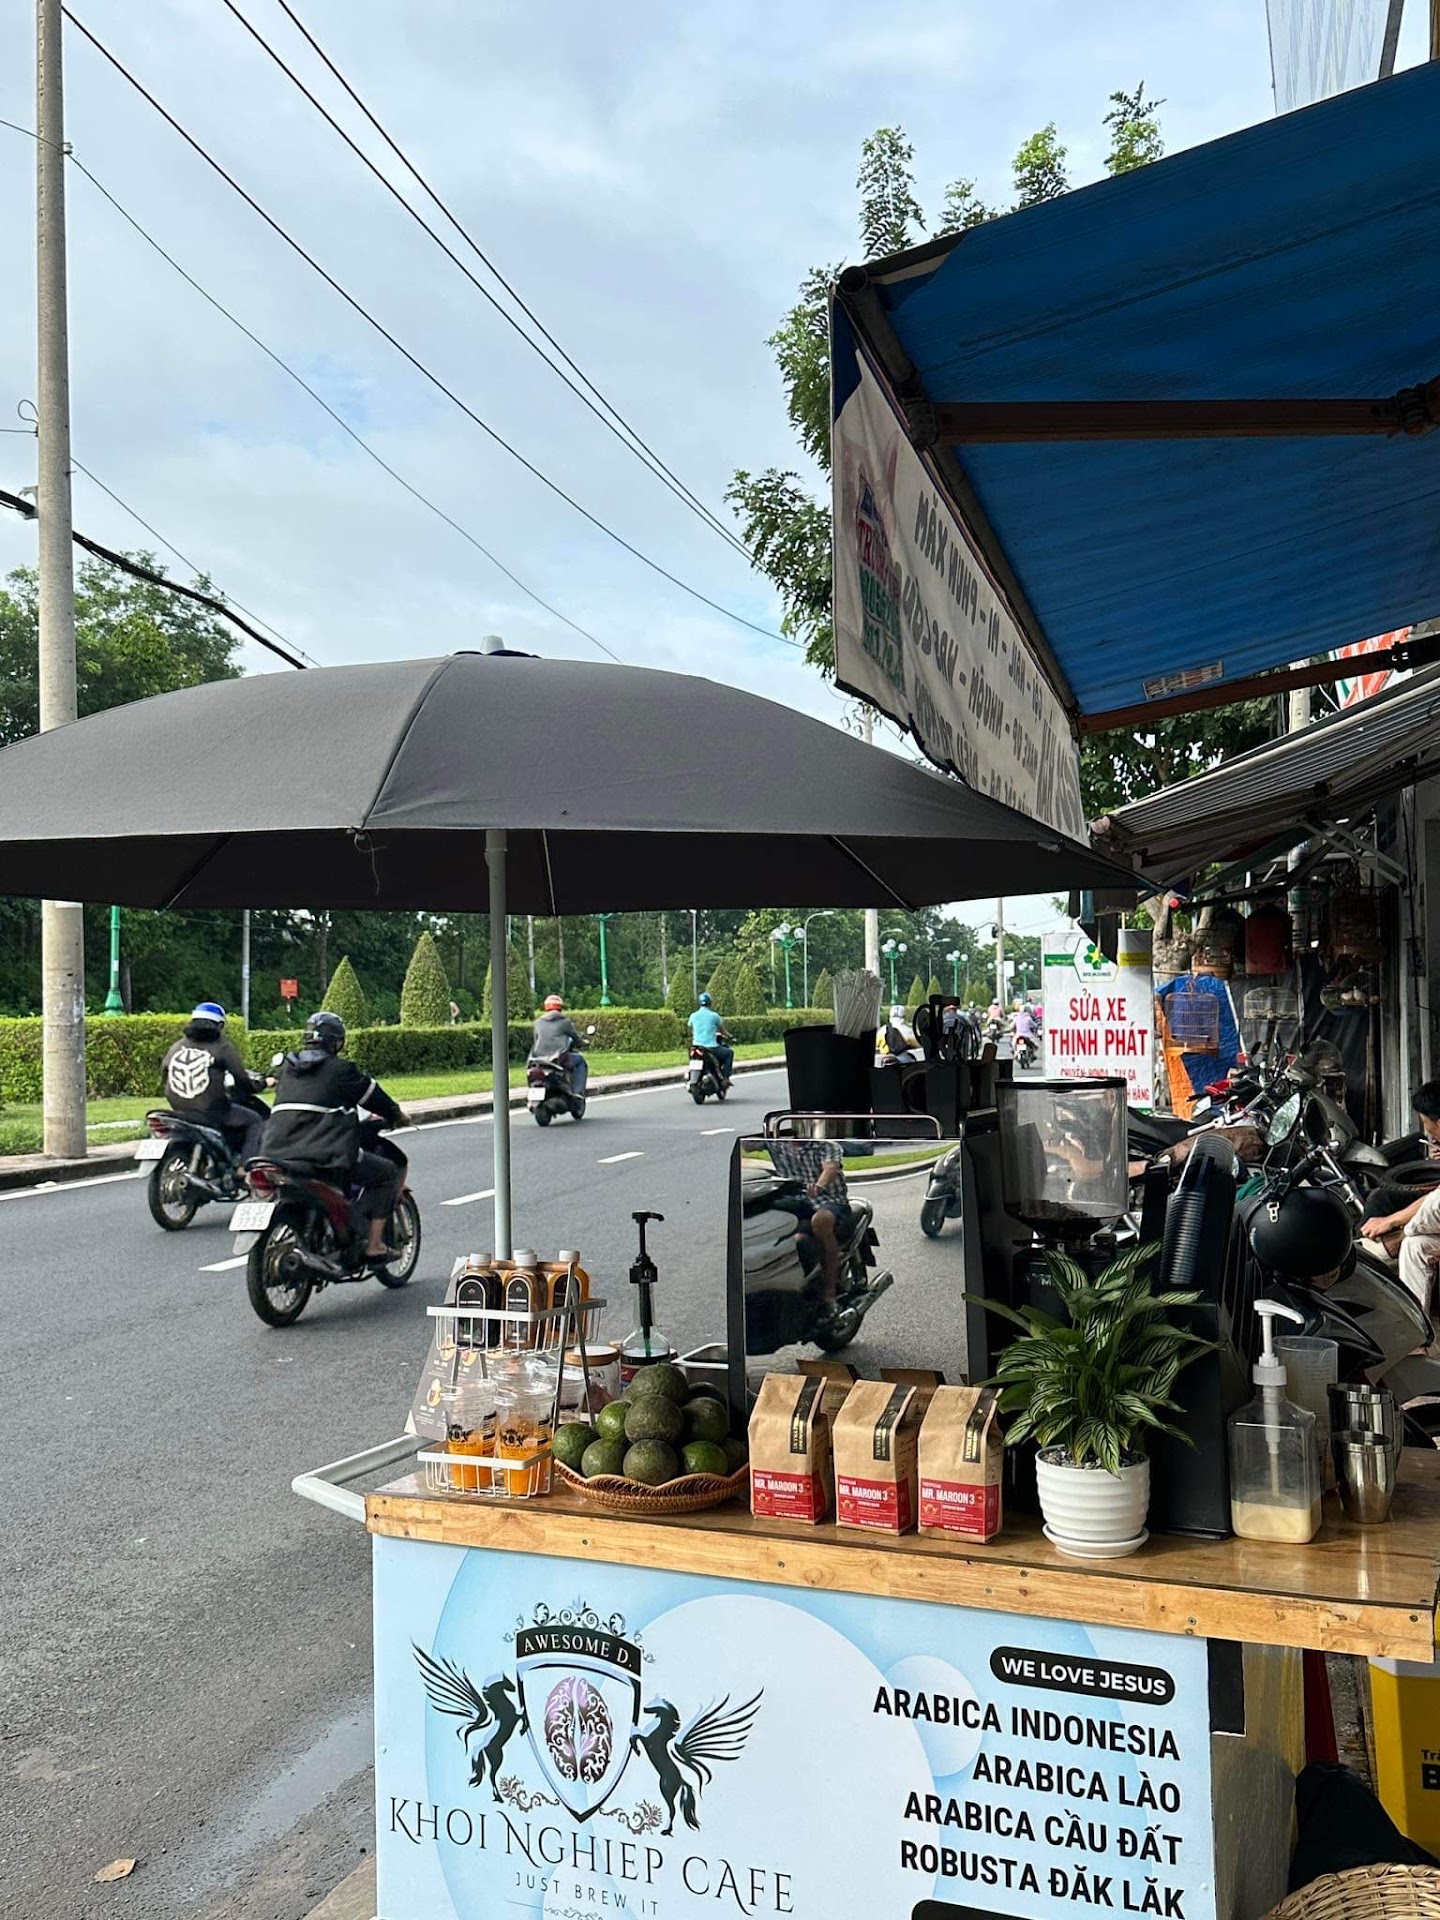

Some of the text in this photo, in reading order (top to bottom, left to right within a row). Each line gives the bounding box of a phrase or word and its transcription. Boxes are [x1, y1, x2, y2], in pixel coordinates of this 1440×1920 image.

[1069, 988, 1127, 1021] SỬA XE
[1050, 1021, 1148, 1063] THỊNH PHÁT
[768, 1479, 798, 1493] MAROON
[798, 1483, 804, 1494] 3
[852, 1486, 882, 1501] MAROON
[882, 1490, 888, 1502] 3
[936, 1489, 969, 1504] MAROON
[969, 1493, 975, 1505] 3
[524, 1633, 632, 1668] AWESOME D.
[1001, 1656, 1167, 1697] WE LOVE JESUS
[873, 1686, 1181, 1762] ARABICA INDONESIA
[972, 1752, 1181, 1813] ARABICA LÀO
[903, 1791, 1183, 1866] ARABICA CẦU ĐẤT
[389, 1796, 795, 1916] KHOI NGHIEP CAFE
[516, 1872, 659, 1916] JUST BREW IT
[901, 1840, 1186, 1920] ROBUSTA ĐĂK LĂK
